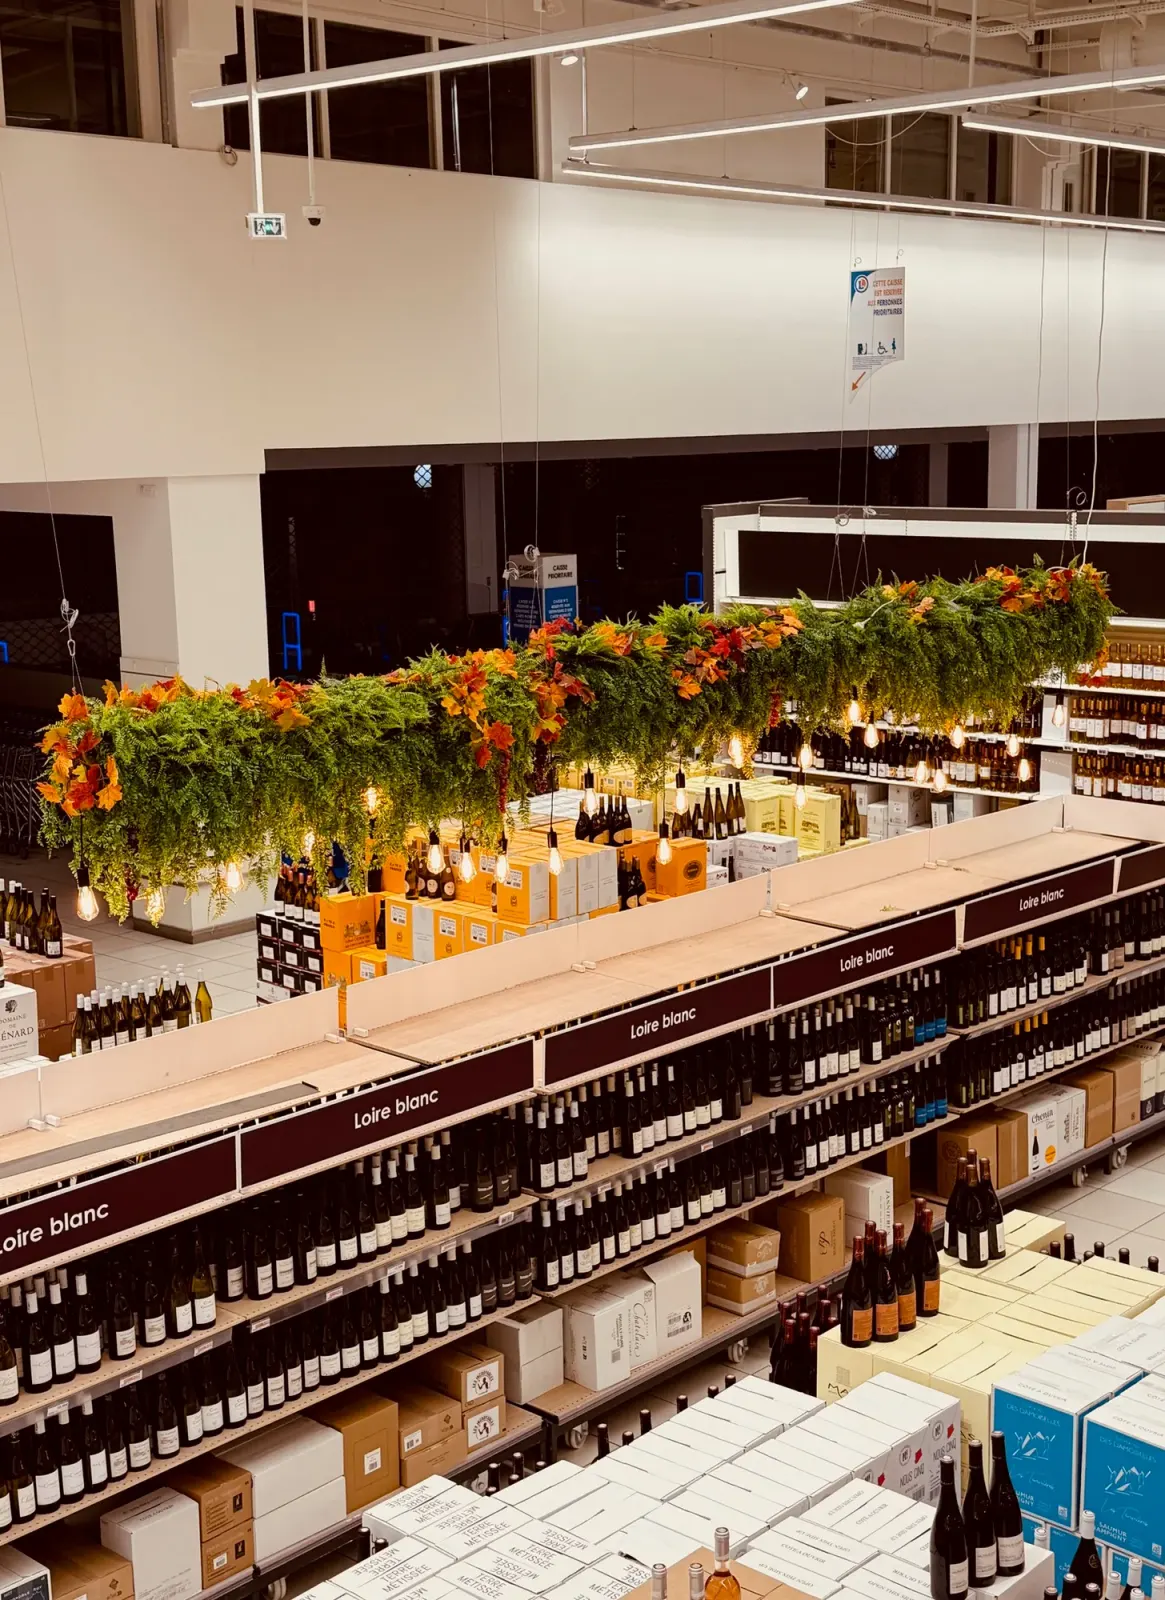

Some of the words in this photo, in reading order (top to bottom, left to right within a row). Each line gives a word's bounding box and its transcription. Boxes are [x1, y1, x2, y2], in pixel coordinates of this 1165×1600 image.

[873, 280, 886, 288] CETTE
[877, 298, 903, 307] PERSONNES
[874, 308, 903, 316] PRIORITAIRES
[548, 572, 573, 580] PRIORITAIRE
[1019, 896, 1039, 911] Loire
[1041, 889, 1065, 905] blanc
[840, 955, 864, 973] Loire
[866, 946, 894, 964] blanc
[631, 1020, 659, 1040] Loire
[663, 1008, 697, 1029] blanc
[1, 1027, 35, 1041] ÉNARD
[355, 1106, 391, 1130] Loire
[396, 1090, 439, 1115] blanc
[1032, 1109, 1054, 1124] Chenin
[50, 1204, 109, 1236] blanc
[900, 1470, 913, 1488] NOUS
[404, 1494, 432, 1510] TERRE
[413, 1499, 444, 1515] TERRE
[415, 1500, 461, 1524] MÉTISSÉE
[454, 1515, 482, 1530] TERRE
[462, 1520, 494, 1537] TERRE
[1099, 1522, 1128, 1537] SAUMUR
[464, 1522, 511, 1547] MÉTISSÉE
[1096, 1528, 1127, 1544] AMPIGNY
[527, 1544, 557, 1560] TERRE
[540, 1538, 571, 1553] TERRE
[509, 1547, 555, 1570] MÉTISSÉE
[802, 1553, 826, 1564] OUVRIR
[369, 1558, 401, 1577] TERRE
[380, 1563, 414, 1583] TERRE
[491, 1566, 521, 1582] TERRE
[382, 1564, 432, 1593] MÉTISSÉE
[476, 1573, 507, 1590] TERRE
[893, 1569, 917, 1583] OUVRIR
[458, 1576, 504, 1599] MÉTISSÉE
[589, 1584, 621, 1600] MÉTIS
[607, 1581, 633, 1593] TERR
[868, 1581, 885, 1591] OPEN
[886, 1588, 900, 1597] THIS
